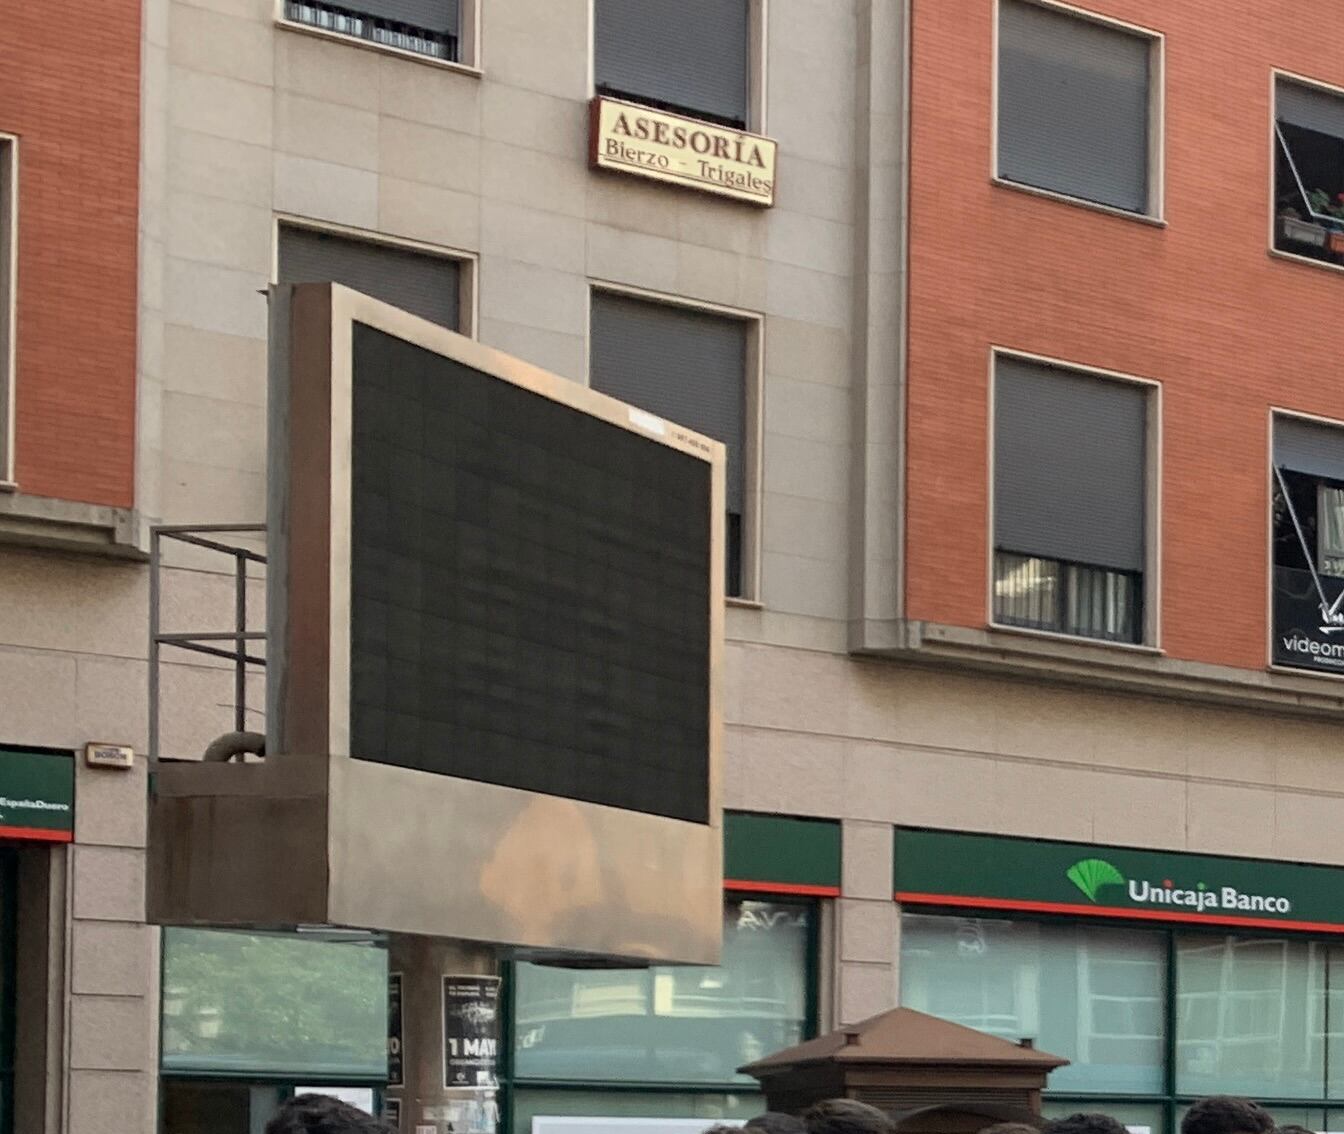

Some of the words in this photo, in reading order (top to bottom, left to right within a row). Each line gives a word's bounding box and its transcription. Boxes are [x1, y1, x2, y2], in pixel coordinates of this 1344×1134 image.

[613, 111, 766, 169] ASESORÍA
[605, 138, 669, 169] Bierzo
[697, 158, 772, 192] Trigales
[1128, 879, 1218, 912] Unicaja
[1221, 887, 1291, 914] Banco
[448, 1038, 458, 1056] 1
[463, 1038, 497, 1057] MAY
